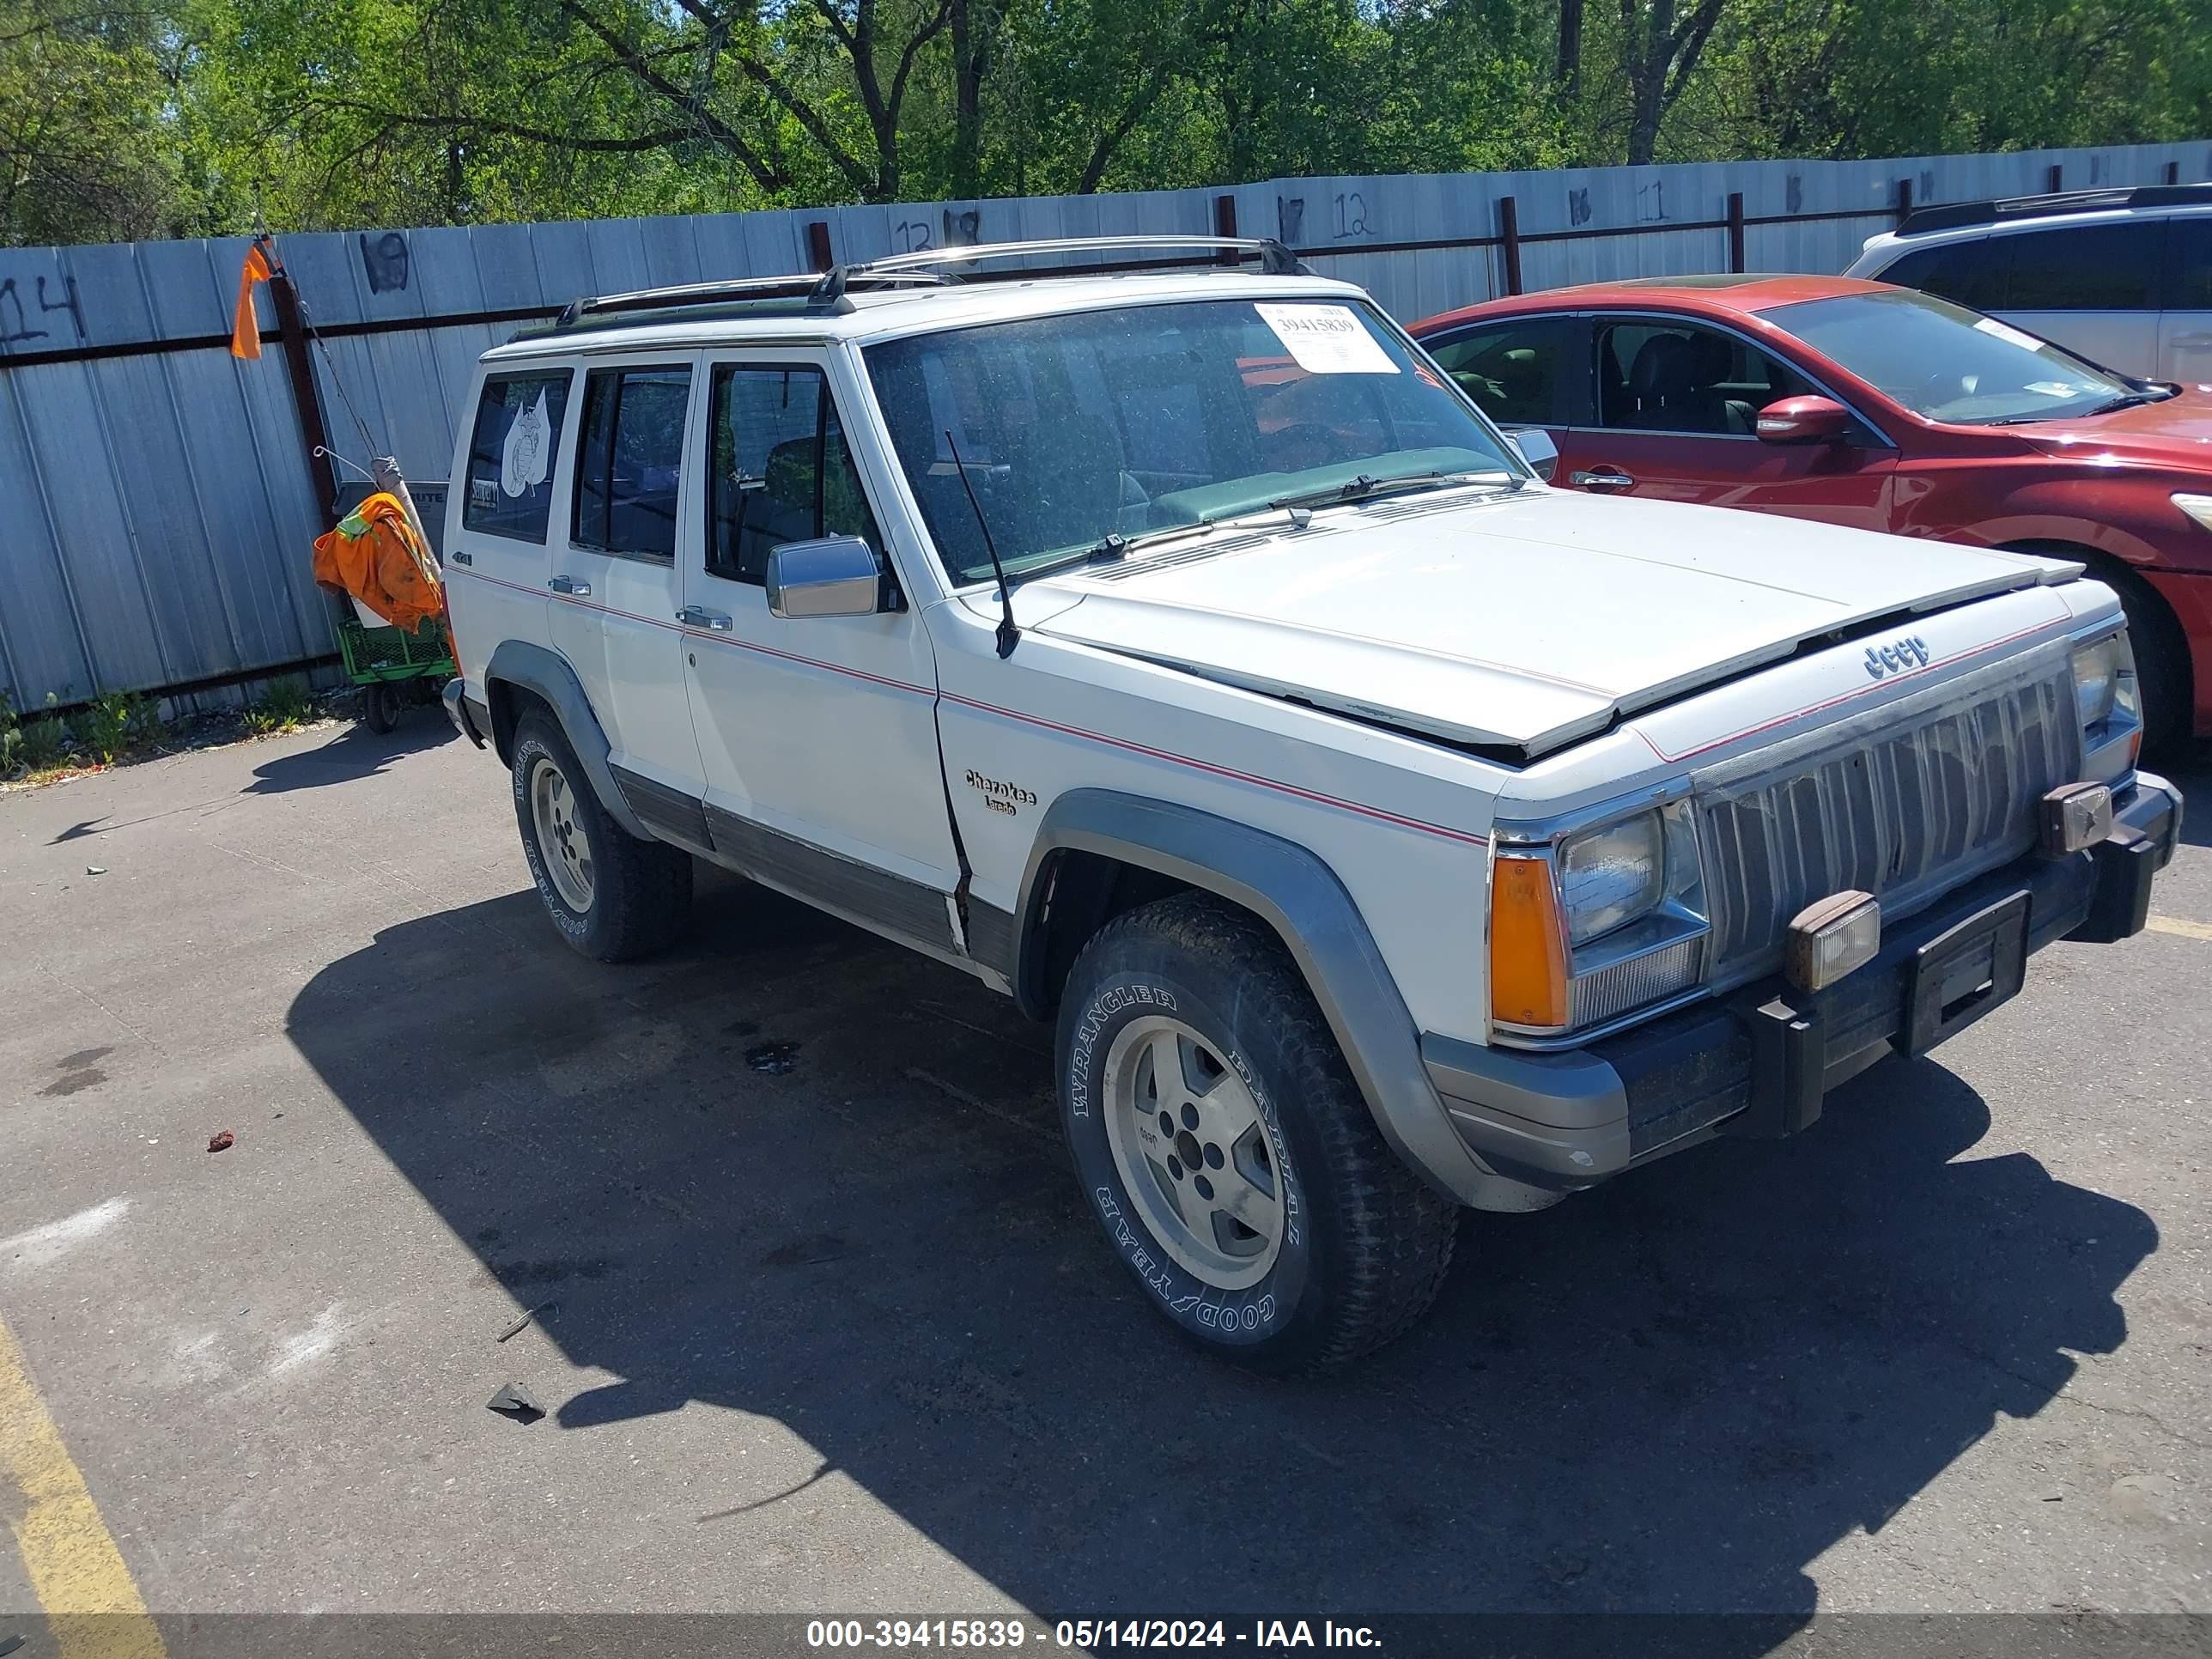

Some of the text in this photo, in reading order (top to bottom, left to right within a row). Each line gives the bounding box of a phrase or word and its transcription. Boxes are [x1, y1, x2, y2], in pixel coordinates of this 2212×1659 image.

[1333, 193, 1377, 239] 12
[896, 222, 933, 252] 12
[1278, 319, 1355, 333] 39415839
[1863, 635, 1929, 680] Jeep
[964, 769, 1037, 806] Cherokee
[984, 795, 1017, 816] Laredo
[1072, 985, 1177, 1117] WRANGLER
[1228, 1050, 1299, 1245] RADIAL
